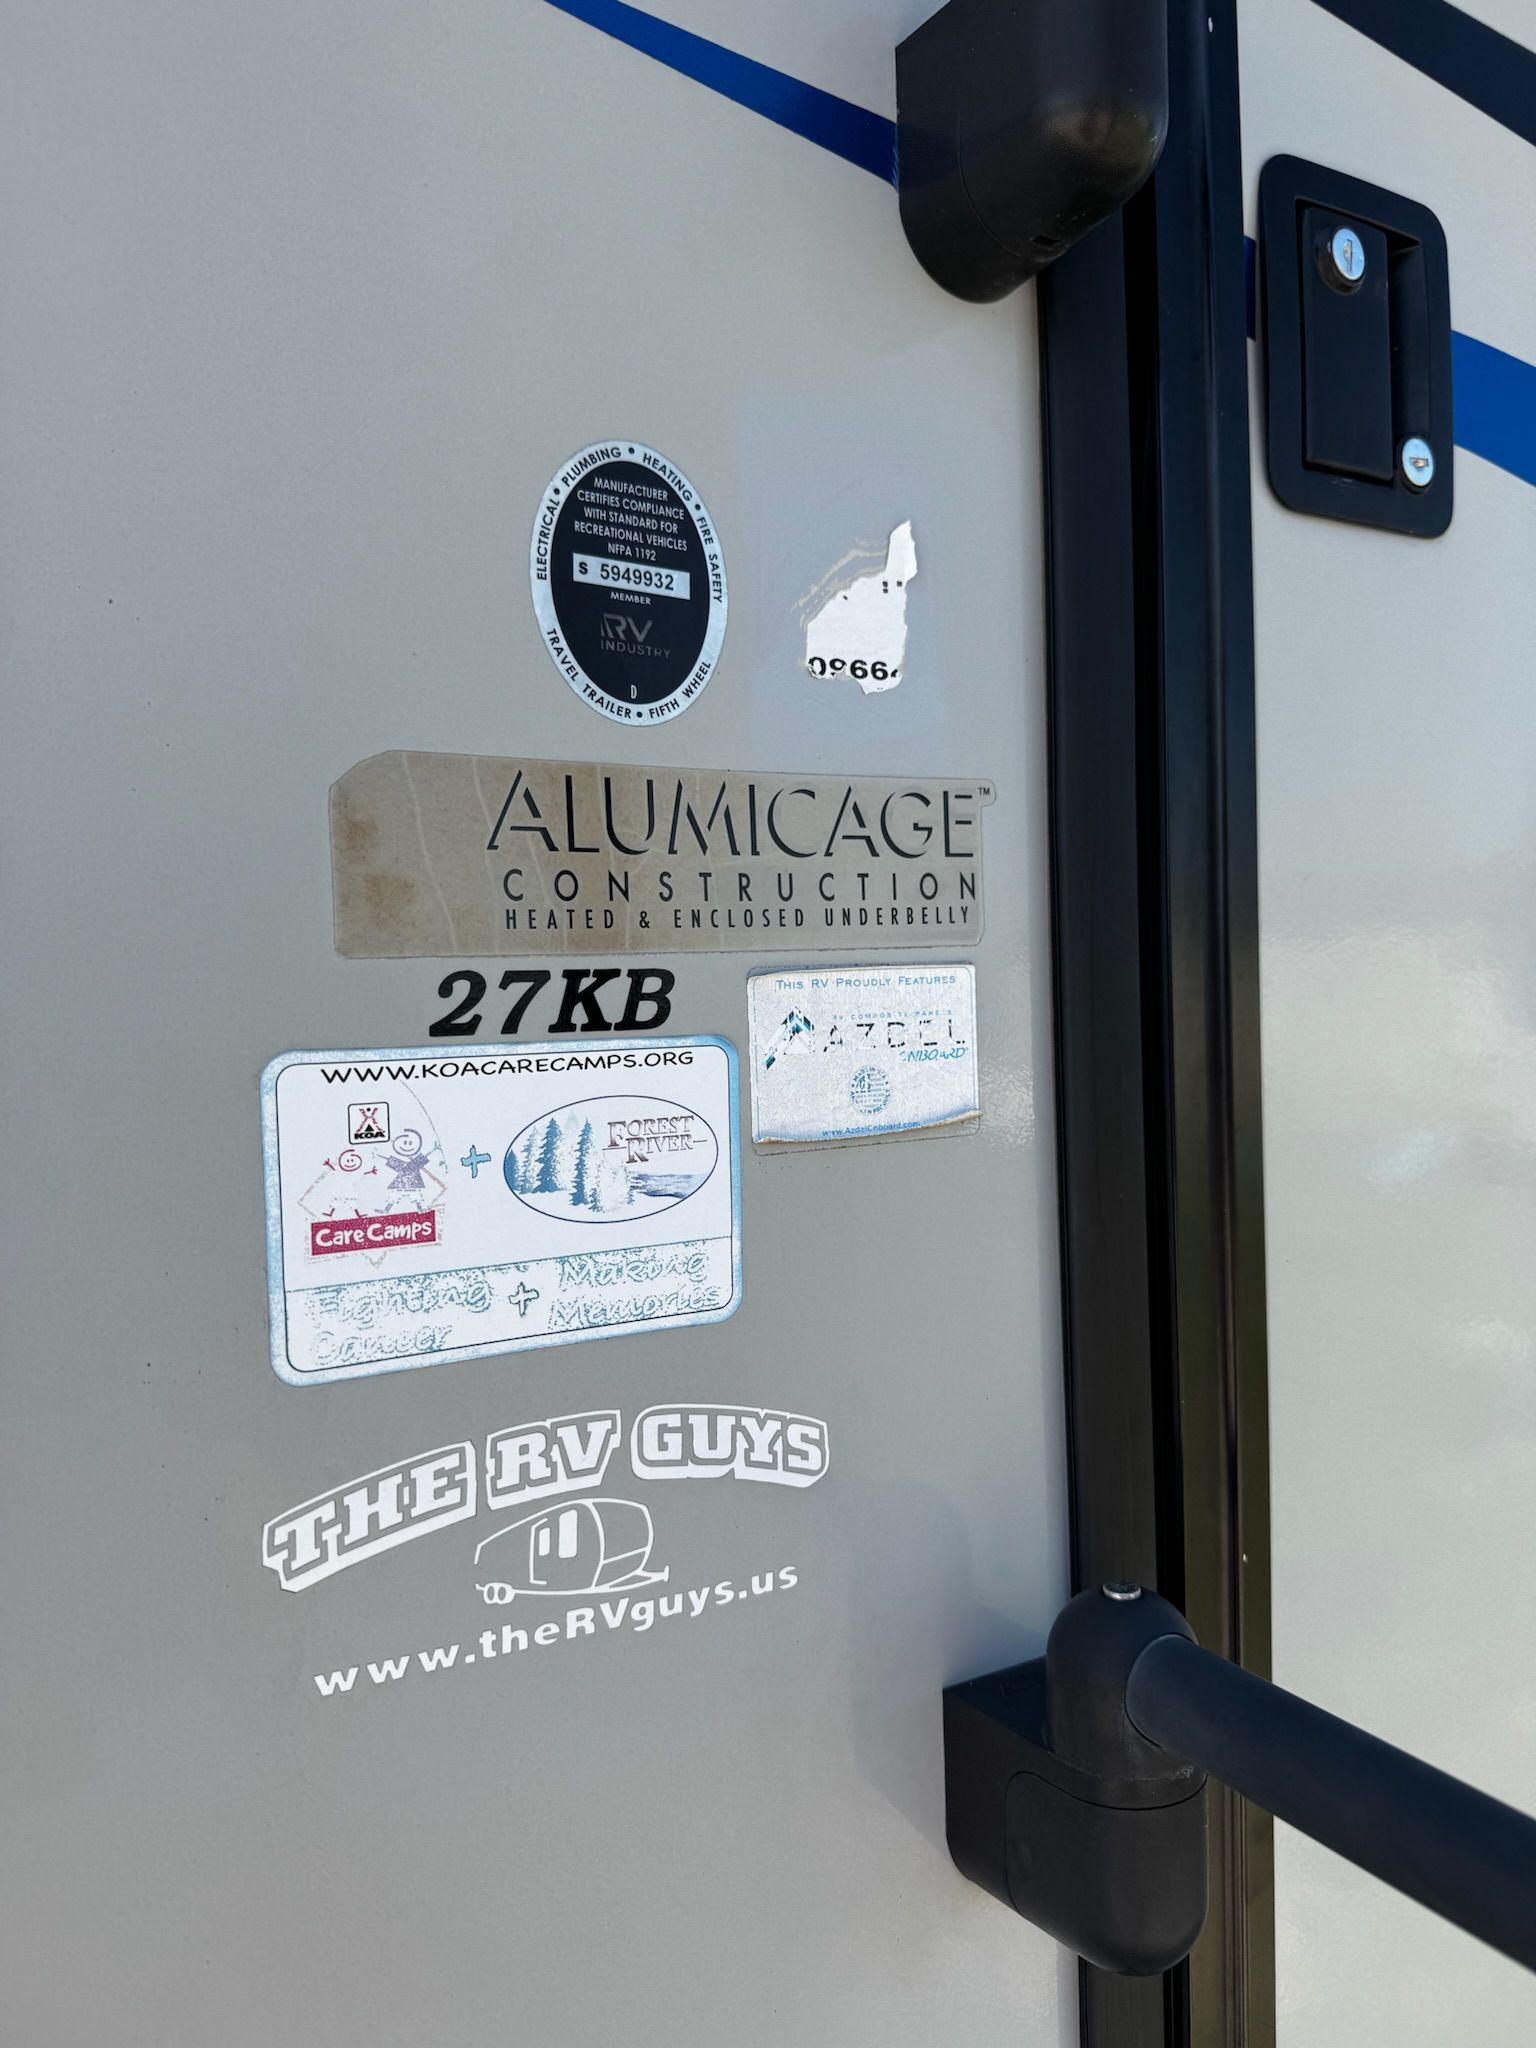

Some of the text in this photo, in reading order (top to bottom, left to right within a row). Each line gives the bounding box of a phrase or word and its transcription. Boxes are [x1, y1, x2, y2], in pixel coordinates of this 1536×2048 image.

[594, 477, 668, 501] MANUFACTURER
[577, 490, 684, 520] CERTIFIES COMPLIANCE
[537, 447, 723, 603] ELECTRICAL PLUMBING HEATING FIRE SAFETY
[583, 507, 678, 534] WITH STANDARD FOR
[574, 521, 687, 551] RECREATIONAL VEHICLES
[607, 542, 656, 561] NFPA 1192
[578, 562, 674, 590] S 5949932
[610, 591, 651, 605] MEMBER
[601, 613, 653, 642] RV
[600, 639, 670, 659] INDUSTRY
[547, 628, 711, 719] TRAVEL TRAILER FIFTH WHEEL
[630, 684, 638, 699] D
[487, 769, 974, 859] ALUMICAGE
[503, 868, 975, 902] CONSTRUCTION
[506, 906, 968, 929] HEATED & ENCLOSED UNDERBELLY
[776, 976, 956, 990] THIS RV PROUDLY FEATURES
[429, 968, 675, 1037] 27KB
[321, 1051, 693, 1083] WWW.KOACARECAMPS.ORG
[354, 1132, 385, 1141] KOA
[608, 1115, 694, 1147] FOREST
[626, 1133, 694, 1163] RIVER
[269, 1411, 826, 1578] THE RV GUYS
[314, 1565, 798, 1697] www.theRVguys.us
